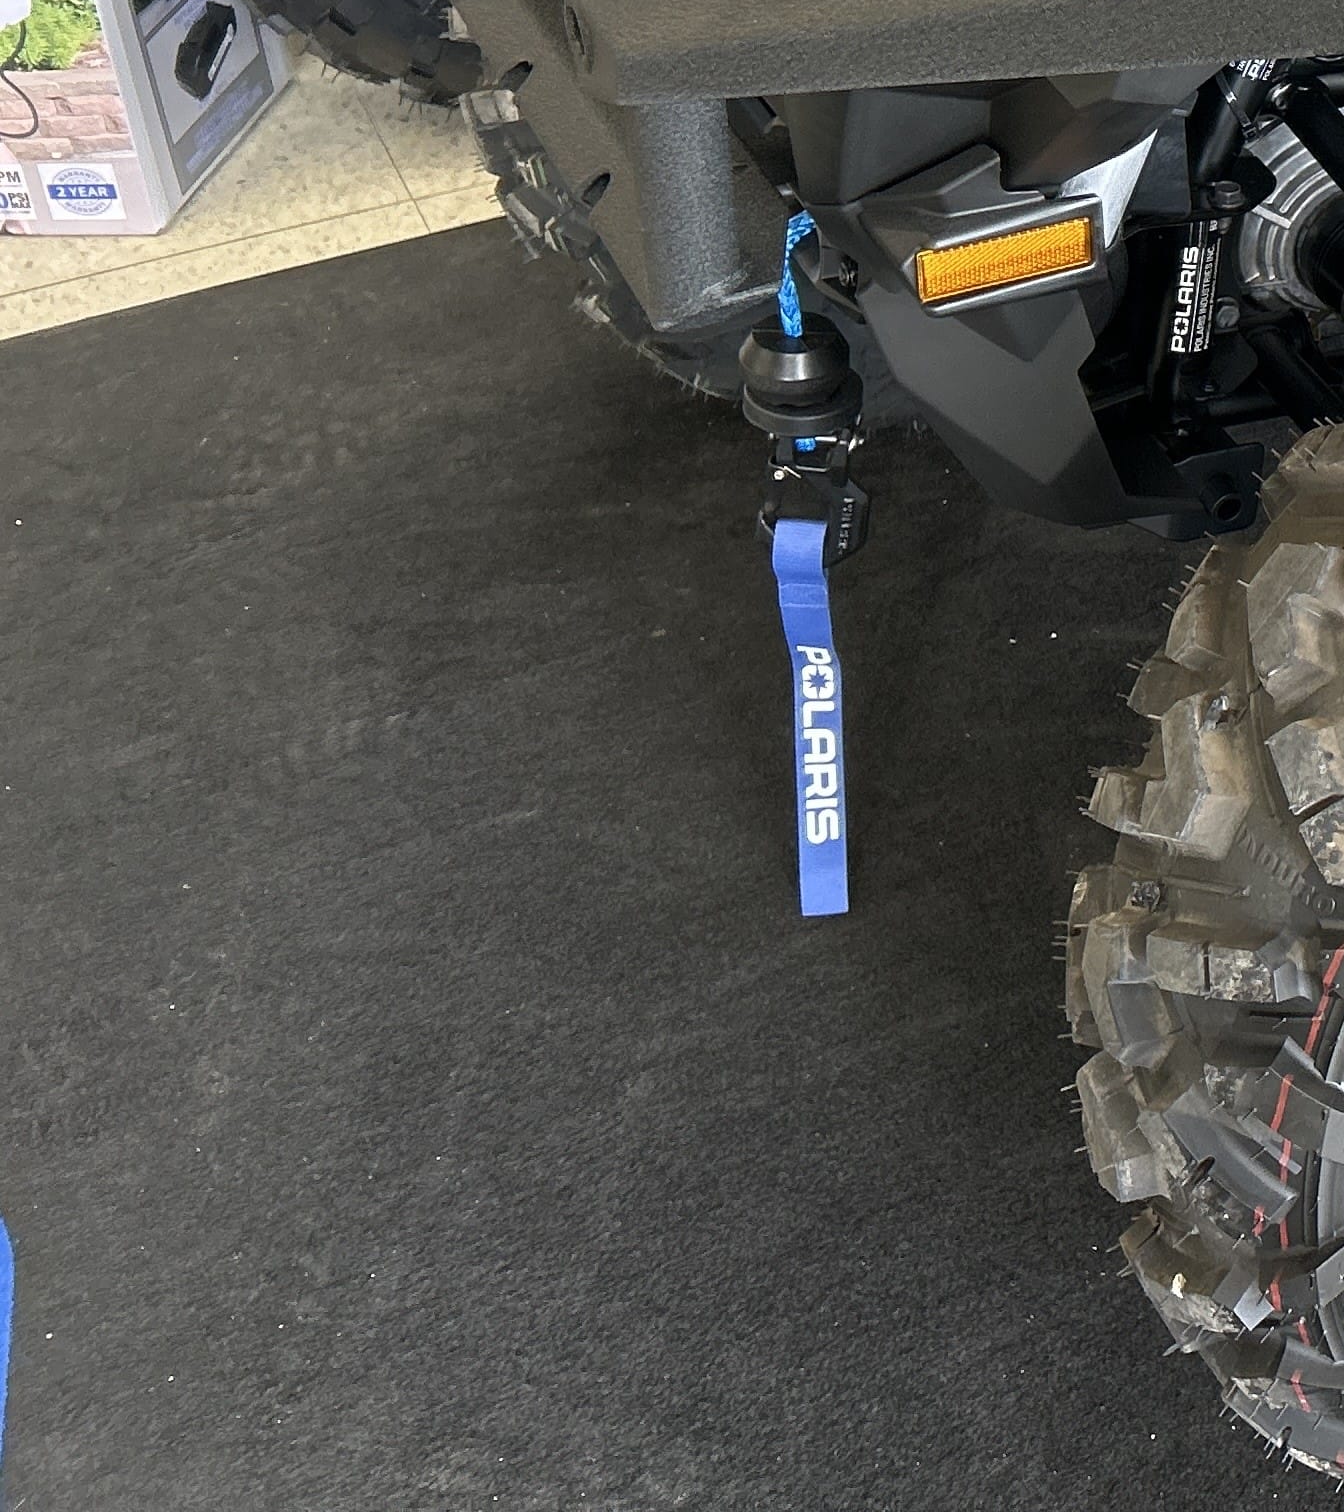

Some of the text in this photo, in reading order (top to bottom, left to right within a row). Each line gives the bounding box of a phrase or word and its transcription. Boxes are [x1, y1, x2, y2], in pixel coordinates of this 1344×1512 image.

[56, 186, 109, 198] 2 YEAR
[1170, 245, 1200, 354] POLARIS
[796, 645, 840, 846] POLARIS
